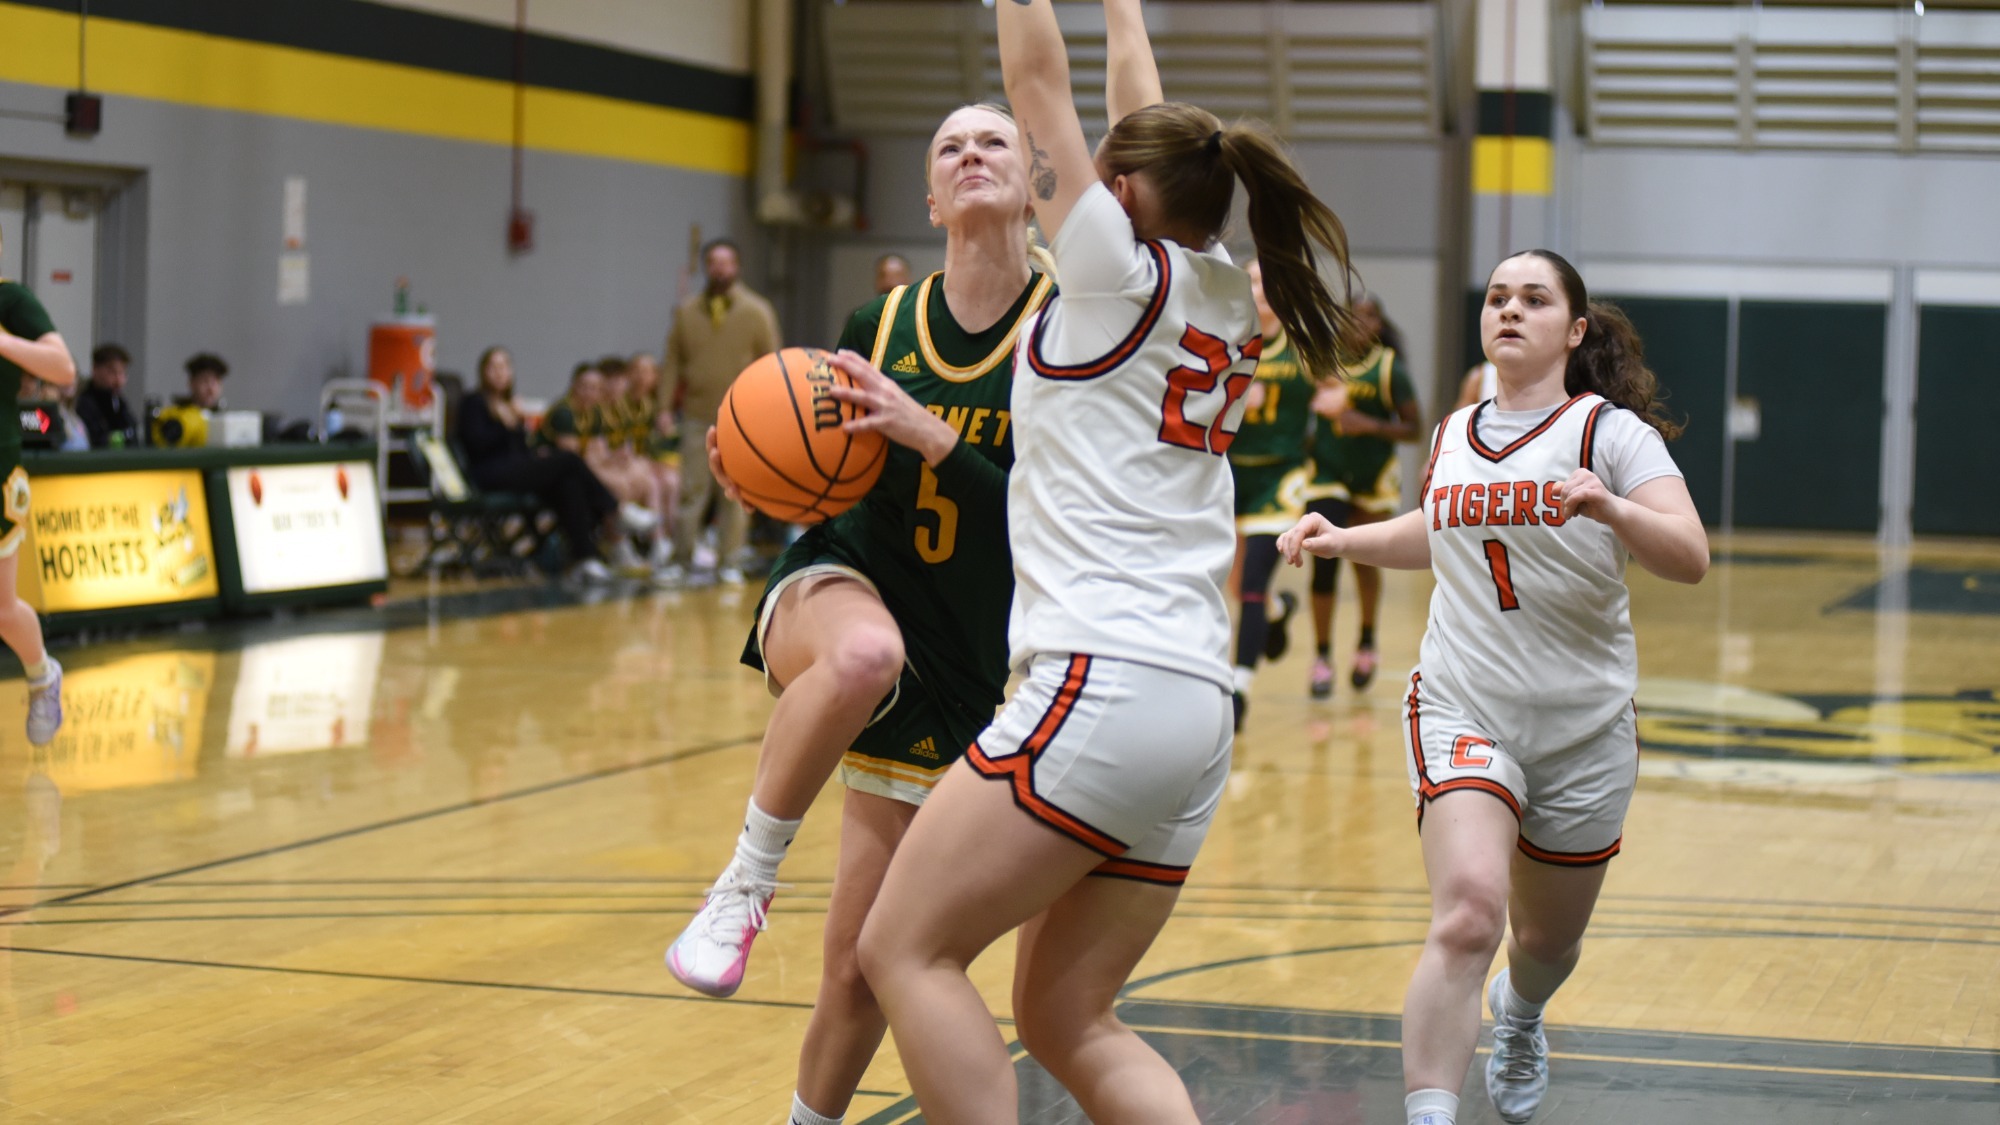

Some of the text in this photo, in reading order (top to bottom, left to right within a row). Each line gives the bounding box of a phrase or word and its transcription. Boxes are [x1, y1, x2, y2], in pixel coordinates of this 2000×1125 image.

[892, 363, 920, 374] adidas
[34, 508, 82, 535] HOME
[914, 461, 958, 564] 5
[1432, 480, 1566, 531] TIGERS
[40, 538, 148, 582] HORNETS
[1482, 538, 1520, 612] 1
[909, 747, 939, 760] adidas
[1449, 734, 1496, 769] C
